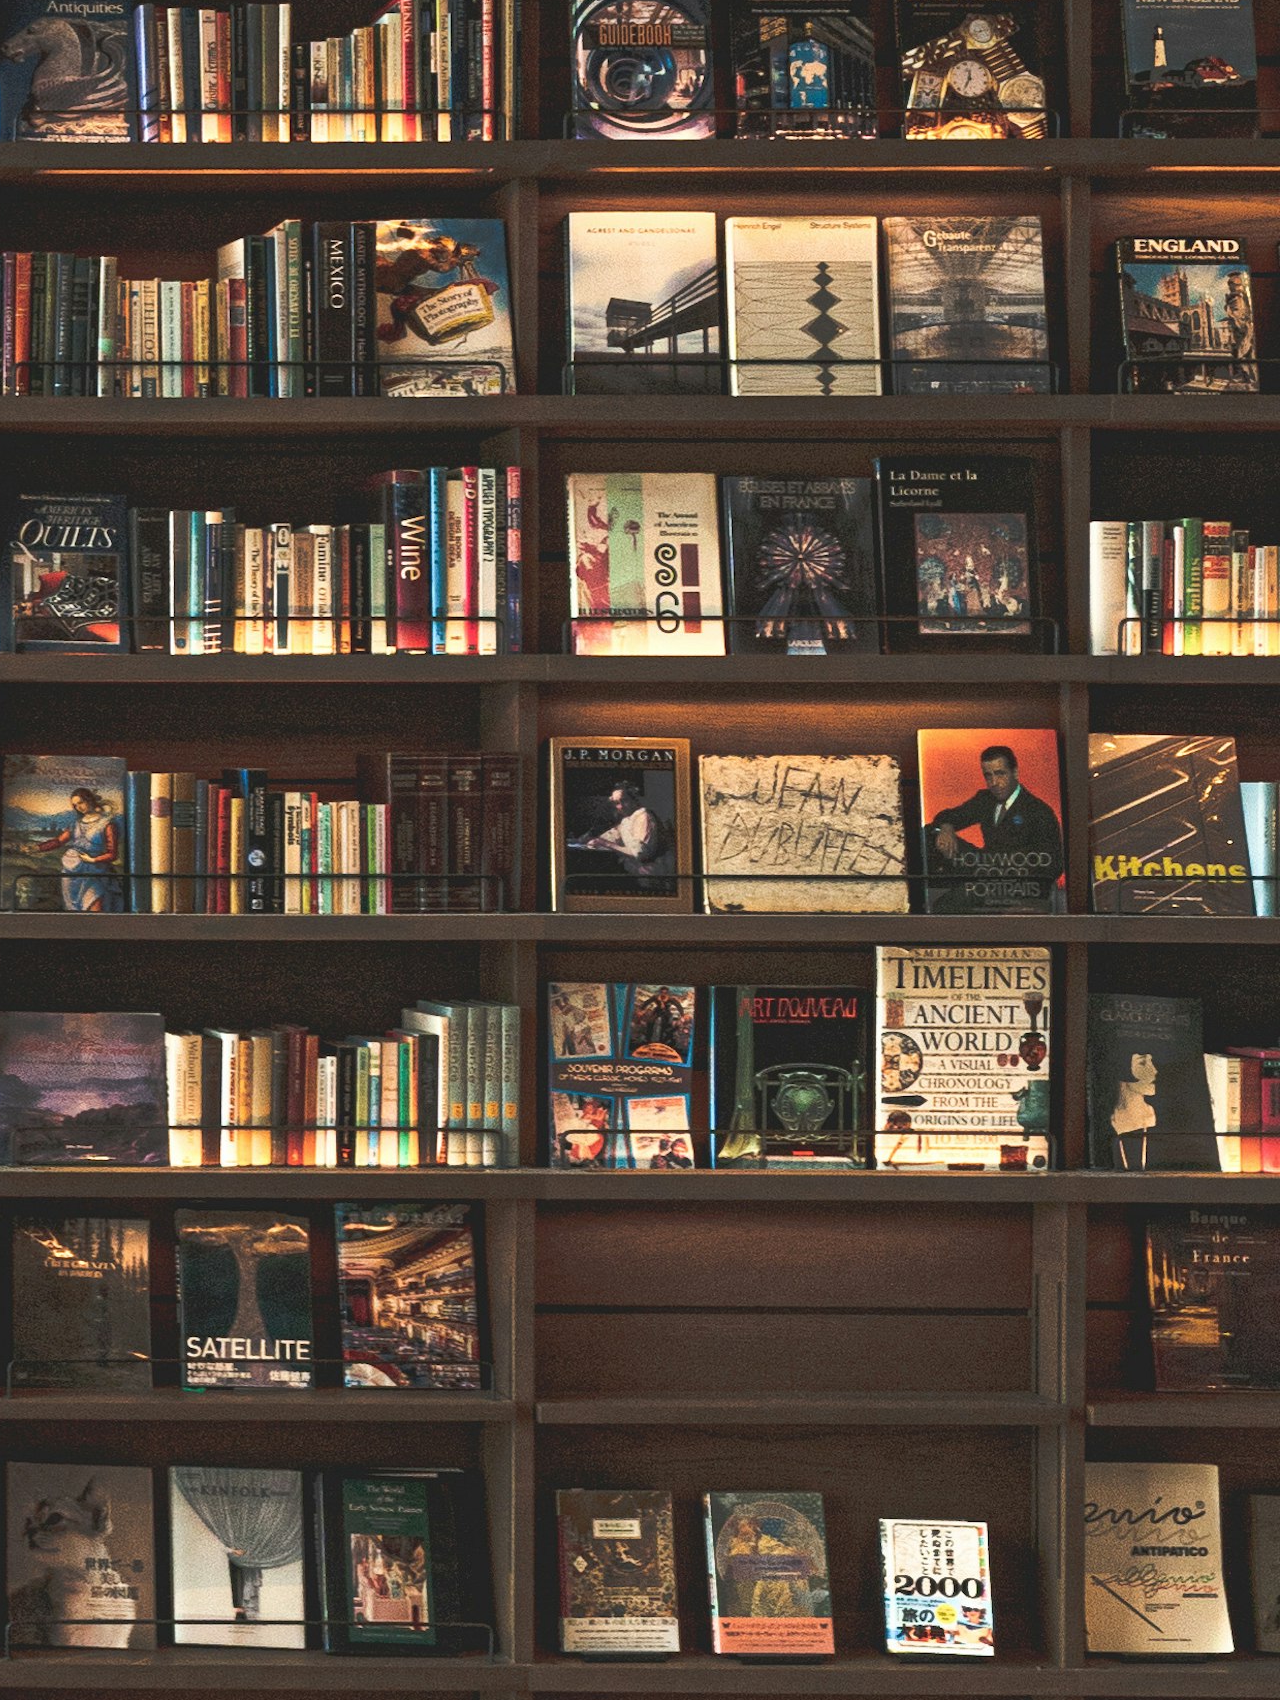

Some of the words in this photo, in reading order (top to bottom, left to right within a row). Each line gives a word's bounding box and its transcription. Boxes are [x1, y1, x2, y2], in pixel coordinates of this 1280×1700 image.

[46, 1, 124, 17] Antiquities
[1134, 238, 1240, 253] ENGLAND
[890, 469, 905, 481] La
[910, 469, 944, 481] Dame
[950, 470, 962, 481] et
[966, 469, 978, 481] la
[890, 486, 939, 497] Licorne
[18, 517, 118, 550] QUILTS
[399, 515, 424, 582] Wine
[1093, 854, 1247, 882] Kitchens
[895, 958, 1047, 991] TIMELINES
[913, 1005, 1020, 1025] ANCIENT
[920, 1031, 1013, 1051] WORLD
[950, 1059, 993, 1071] VISUAL
[918, 1077, 1012, 1090] CHRONOLOGY
[932, 1095, 970, 1108] FROM
[972, 1096, 999, 1108] THE
[913, 1114, 969, 1127] ORIGINS
[971, 1114, 987, 1126] OF
[989, 1115, 1018, 1127] LIFE
[185, 1337, 311, 1360] SATELLITE
[893, 1575, 983, 1599] 2000
